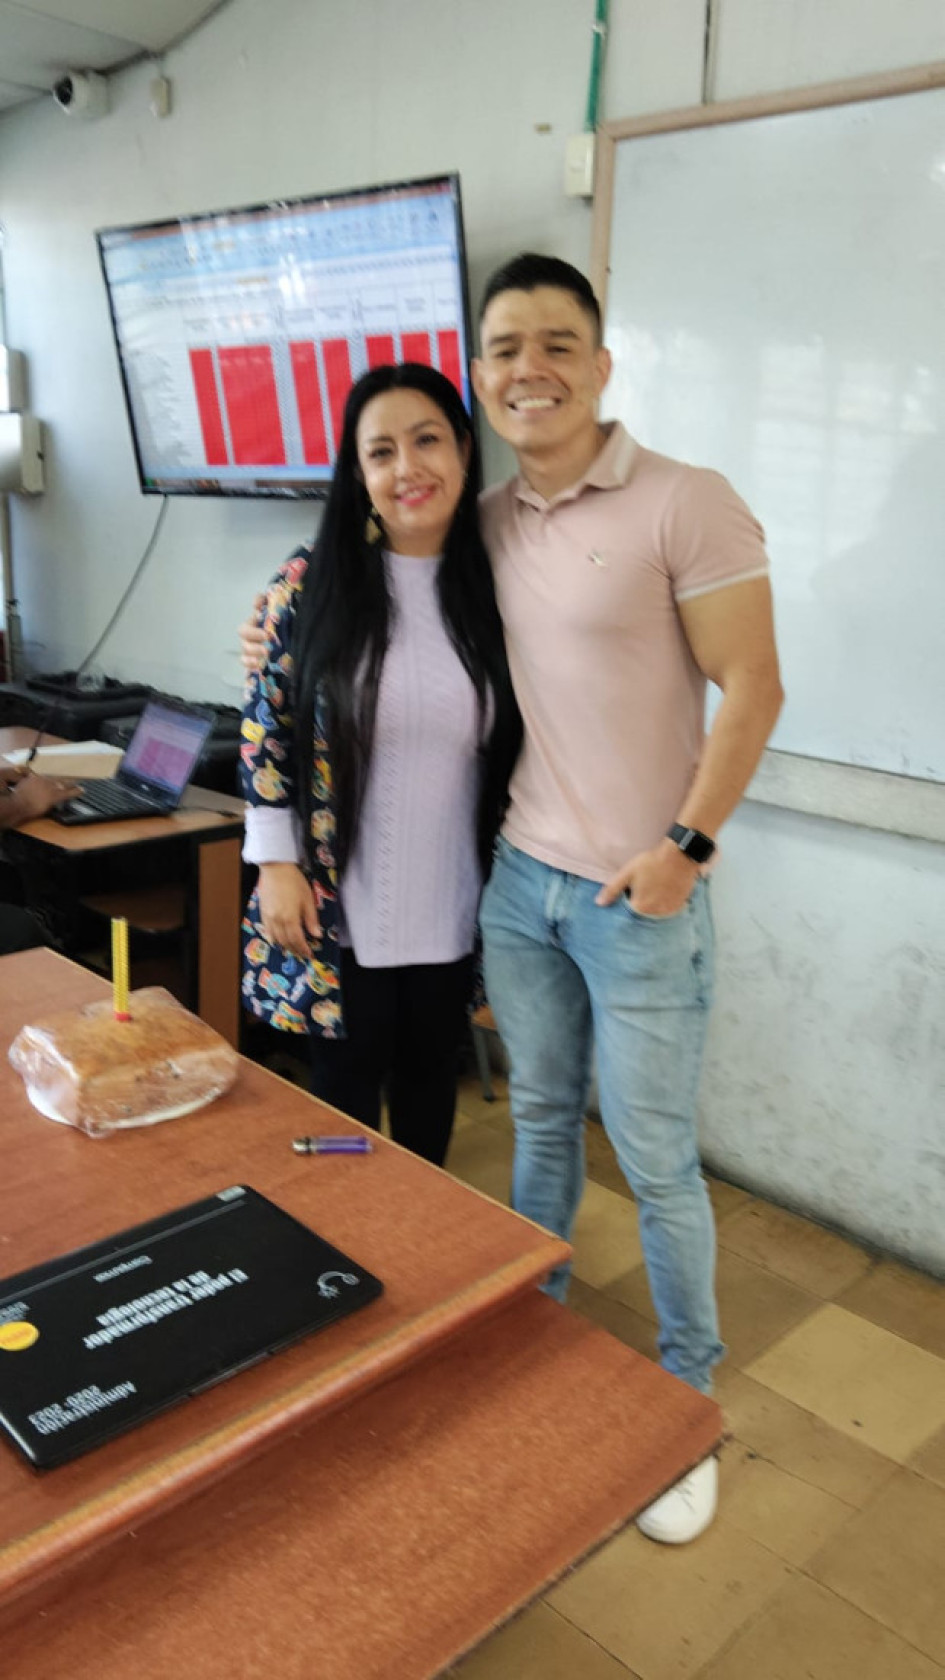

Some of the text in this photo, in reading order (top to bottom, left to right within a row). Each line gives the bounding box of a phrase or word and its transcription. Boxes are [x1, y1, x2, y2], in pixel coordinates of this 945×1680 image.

[172, 1279, 193, 1293] la
[188, 1270, 212, 1286] de
[82, 1268, 249, 1349] El poder transformador
